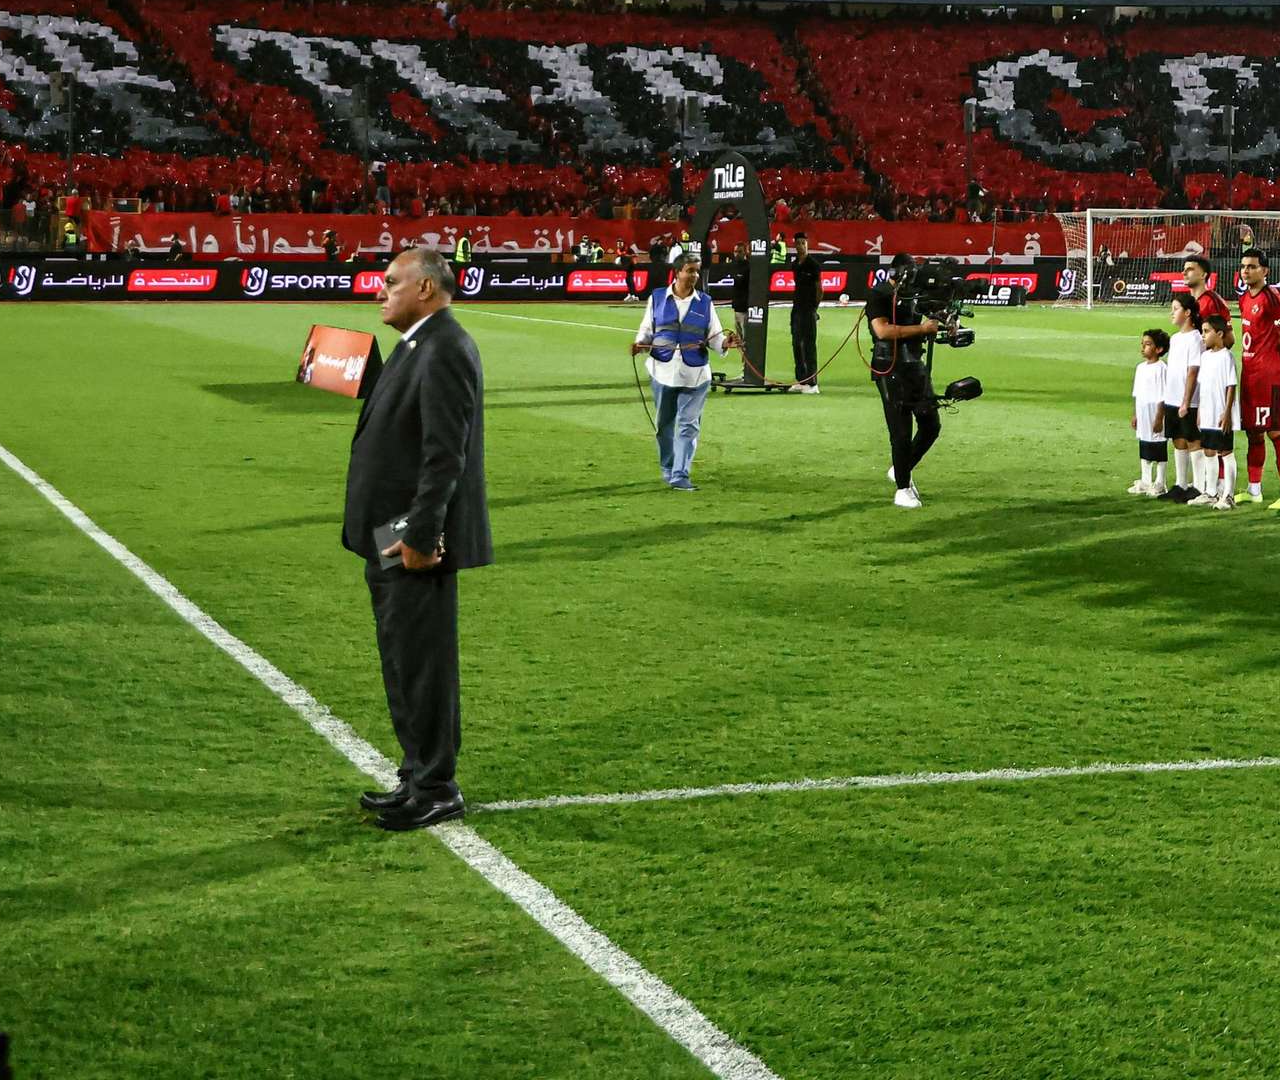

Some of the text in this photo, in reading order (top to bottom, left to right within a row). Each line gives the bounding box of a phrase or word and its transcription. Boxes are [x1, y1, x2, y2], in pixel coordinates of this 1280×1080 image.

[42, 272, 211, 291] المتحدة للرياضة
[271, 275, 352, 290] SPORTS
[490, 273, 564, 291] للرياضة
[1255, 406, 1271, 426] 17
